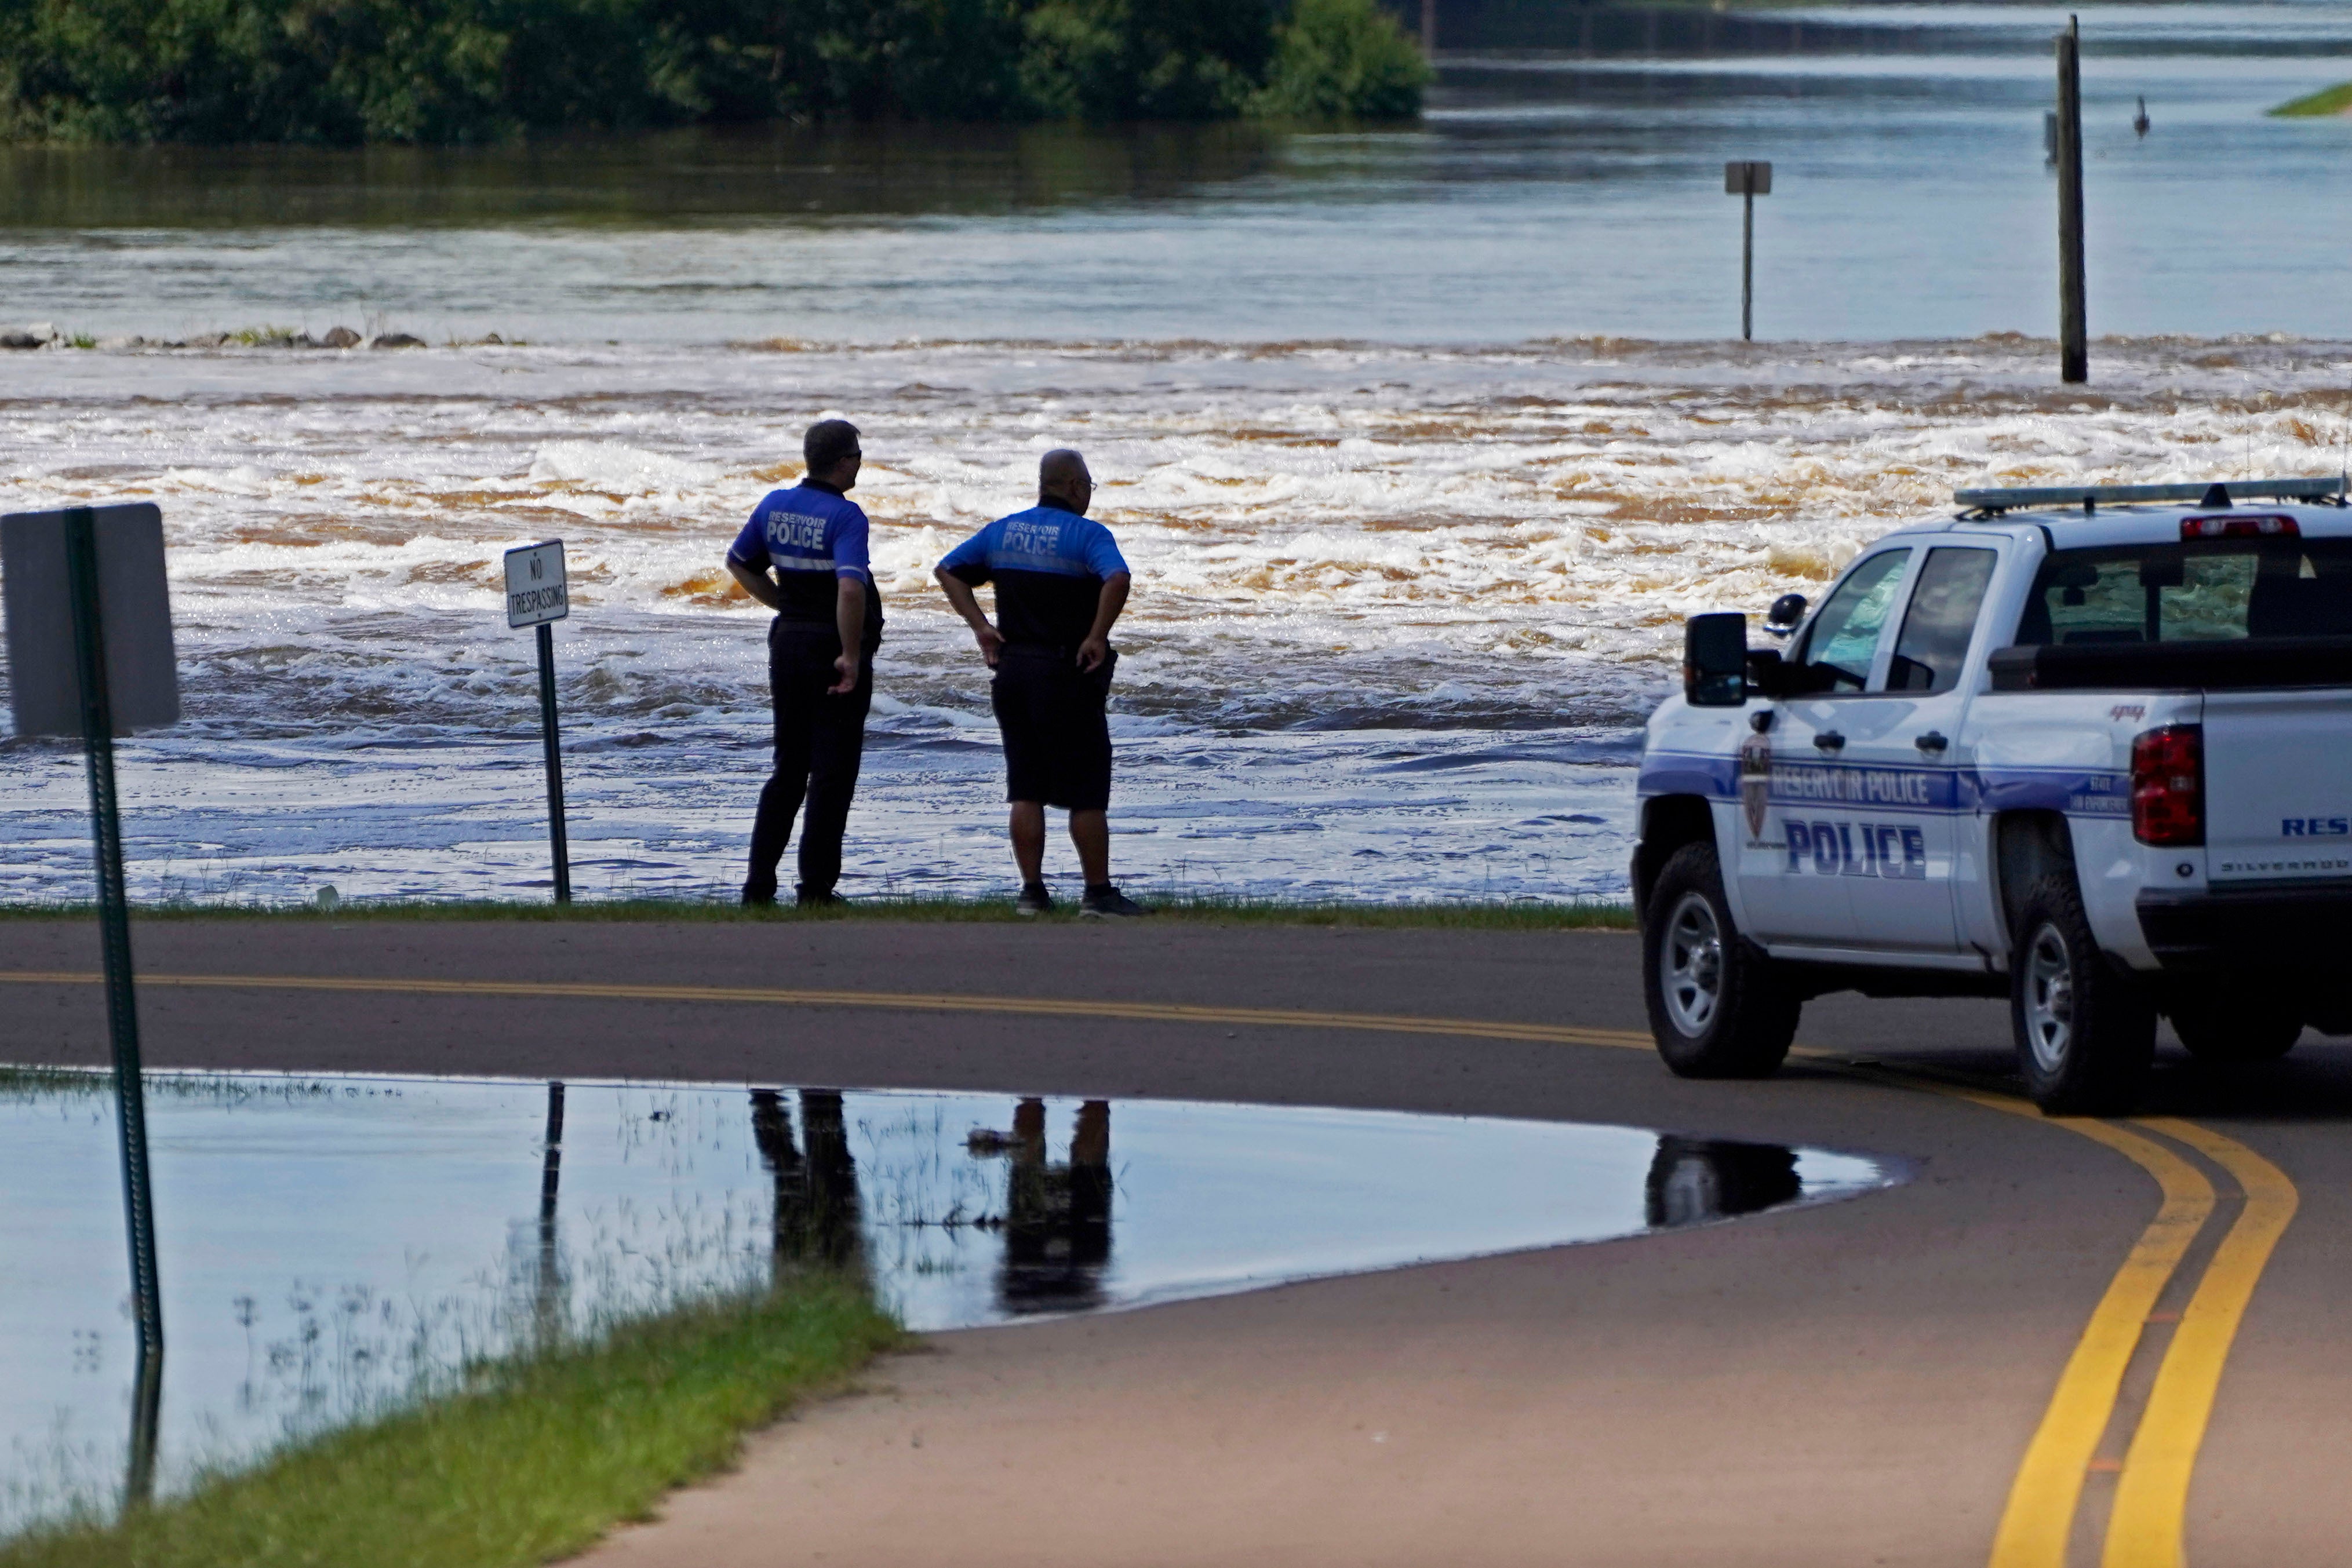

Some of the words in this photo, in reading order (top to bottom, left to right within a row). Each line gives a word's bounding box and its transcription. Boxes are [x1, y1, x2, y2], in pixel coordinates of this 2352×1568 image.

[769, 511, 827, 528] RESERVOIR
[767, 521, 824, 550] POLICE
[1002, 531, 1058, 556] POLICE
[530, 558, 542, 581] NO
[510, 584, 563, 616] TRESPASSING
[1772, 765, 1863, 801] RESERVOIR
[1865, 770, 1929, 804] POLICE
[2282, 817, 2352, 836] RES
[1783, 820, 1926, 880] POLICE
